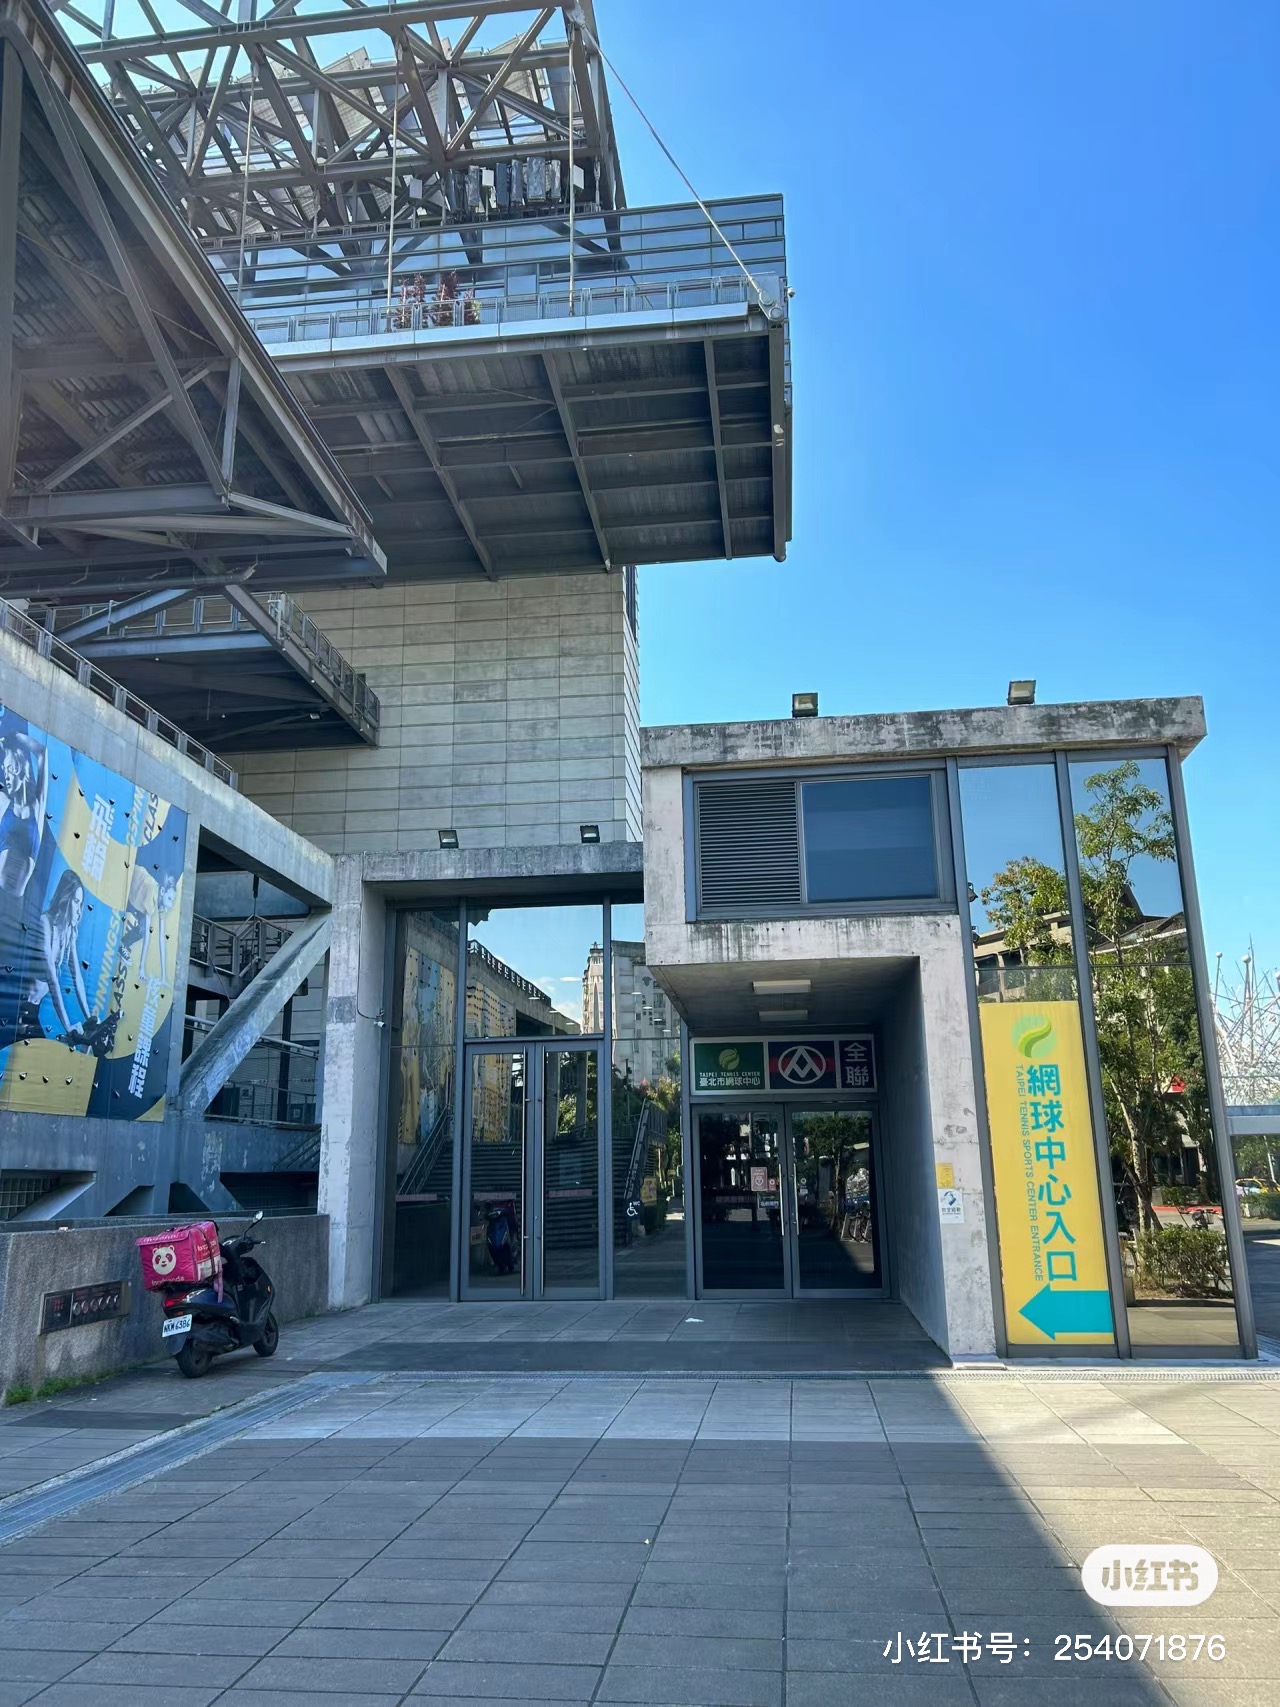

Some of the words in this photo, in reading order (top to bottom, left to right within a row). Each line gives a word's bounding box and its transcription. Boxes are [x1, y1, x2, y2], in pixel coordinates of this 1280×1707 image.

[699, 1077, 761, 1087] 臺北市網球中心
[844, 1042, 869, 1087] 全聯
[1015, 1064, 1026, 1097] TAIPEI
[1019, 1101, 1030, 1136] TENNIS
[1022, 1139, 1034, 1178] SPORTS
[1026, 1063, 1077, 1281] 網球中心入口
[1026, 1181, 1038, 1221] CENTER
[1030, 1225, 1043, 1281] ENTRANCE
